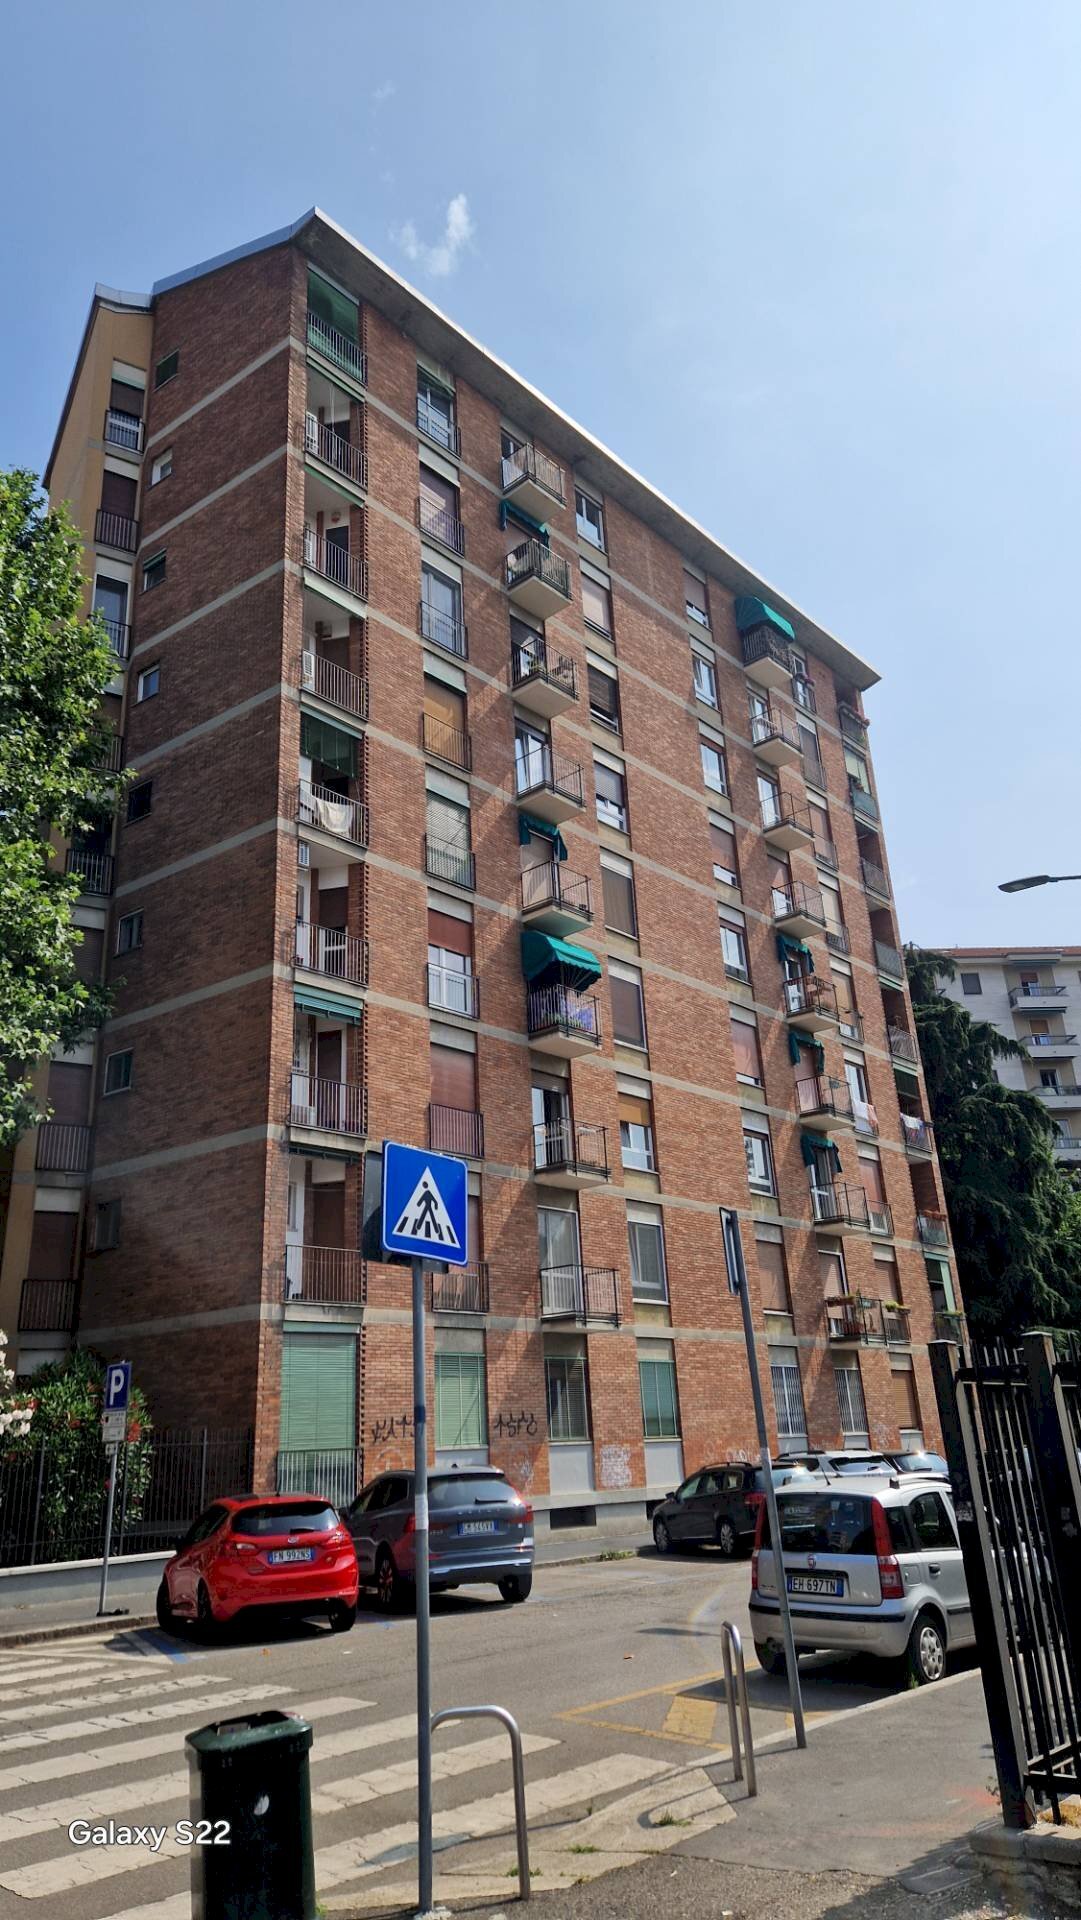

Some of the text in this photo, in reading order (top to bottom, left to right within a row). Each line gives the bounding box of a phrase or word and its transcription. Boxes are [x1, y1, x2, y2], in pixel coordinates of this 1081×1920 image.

[109, 1368, 125, 1406] P
[793, 1577, 804, 1591] EH
[806, 1578, 836, 1593] 697TN
